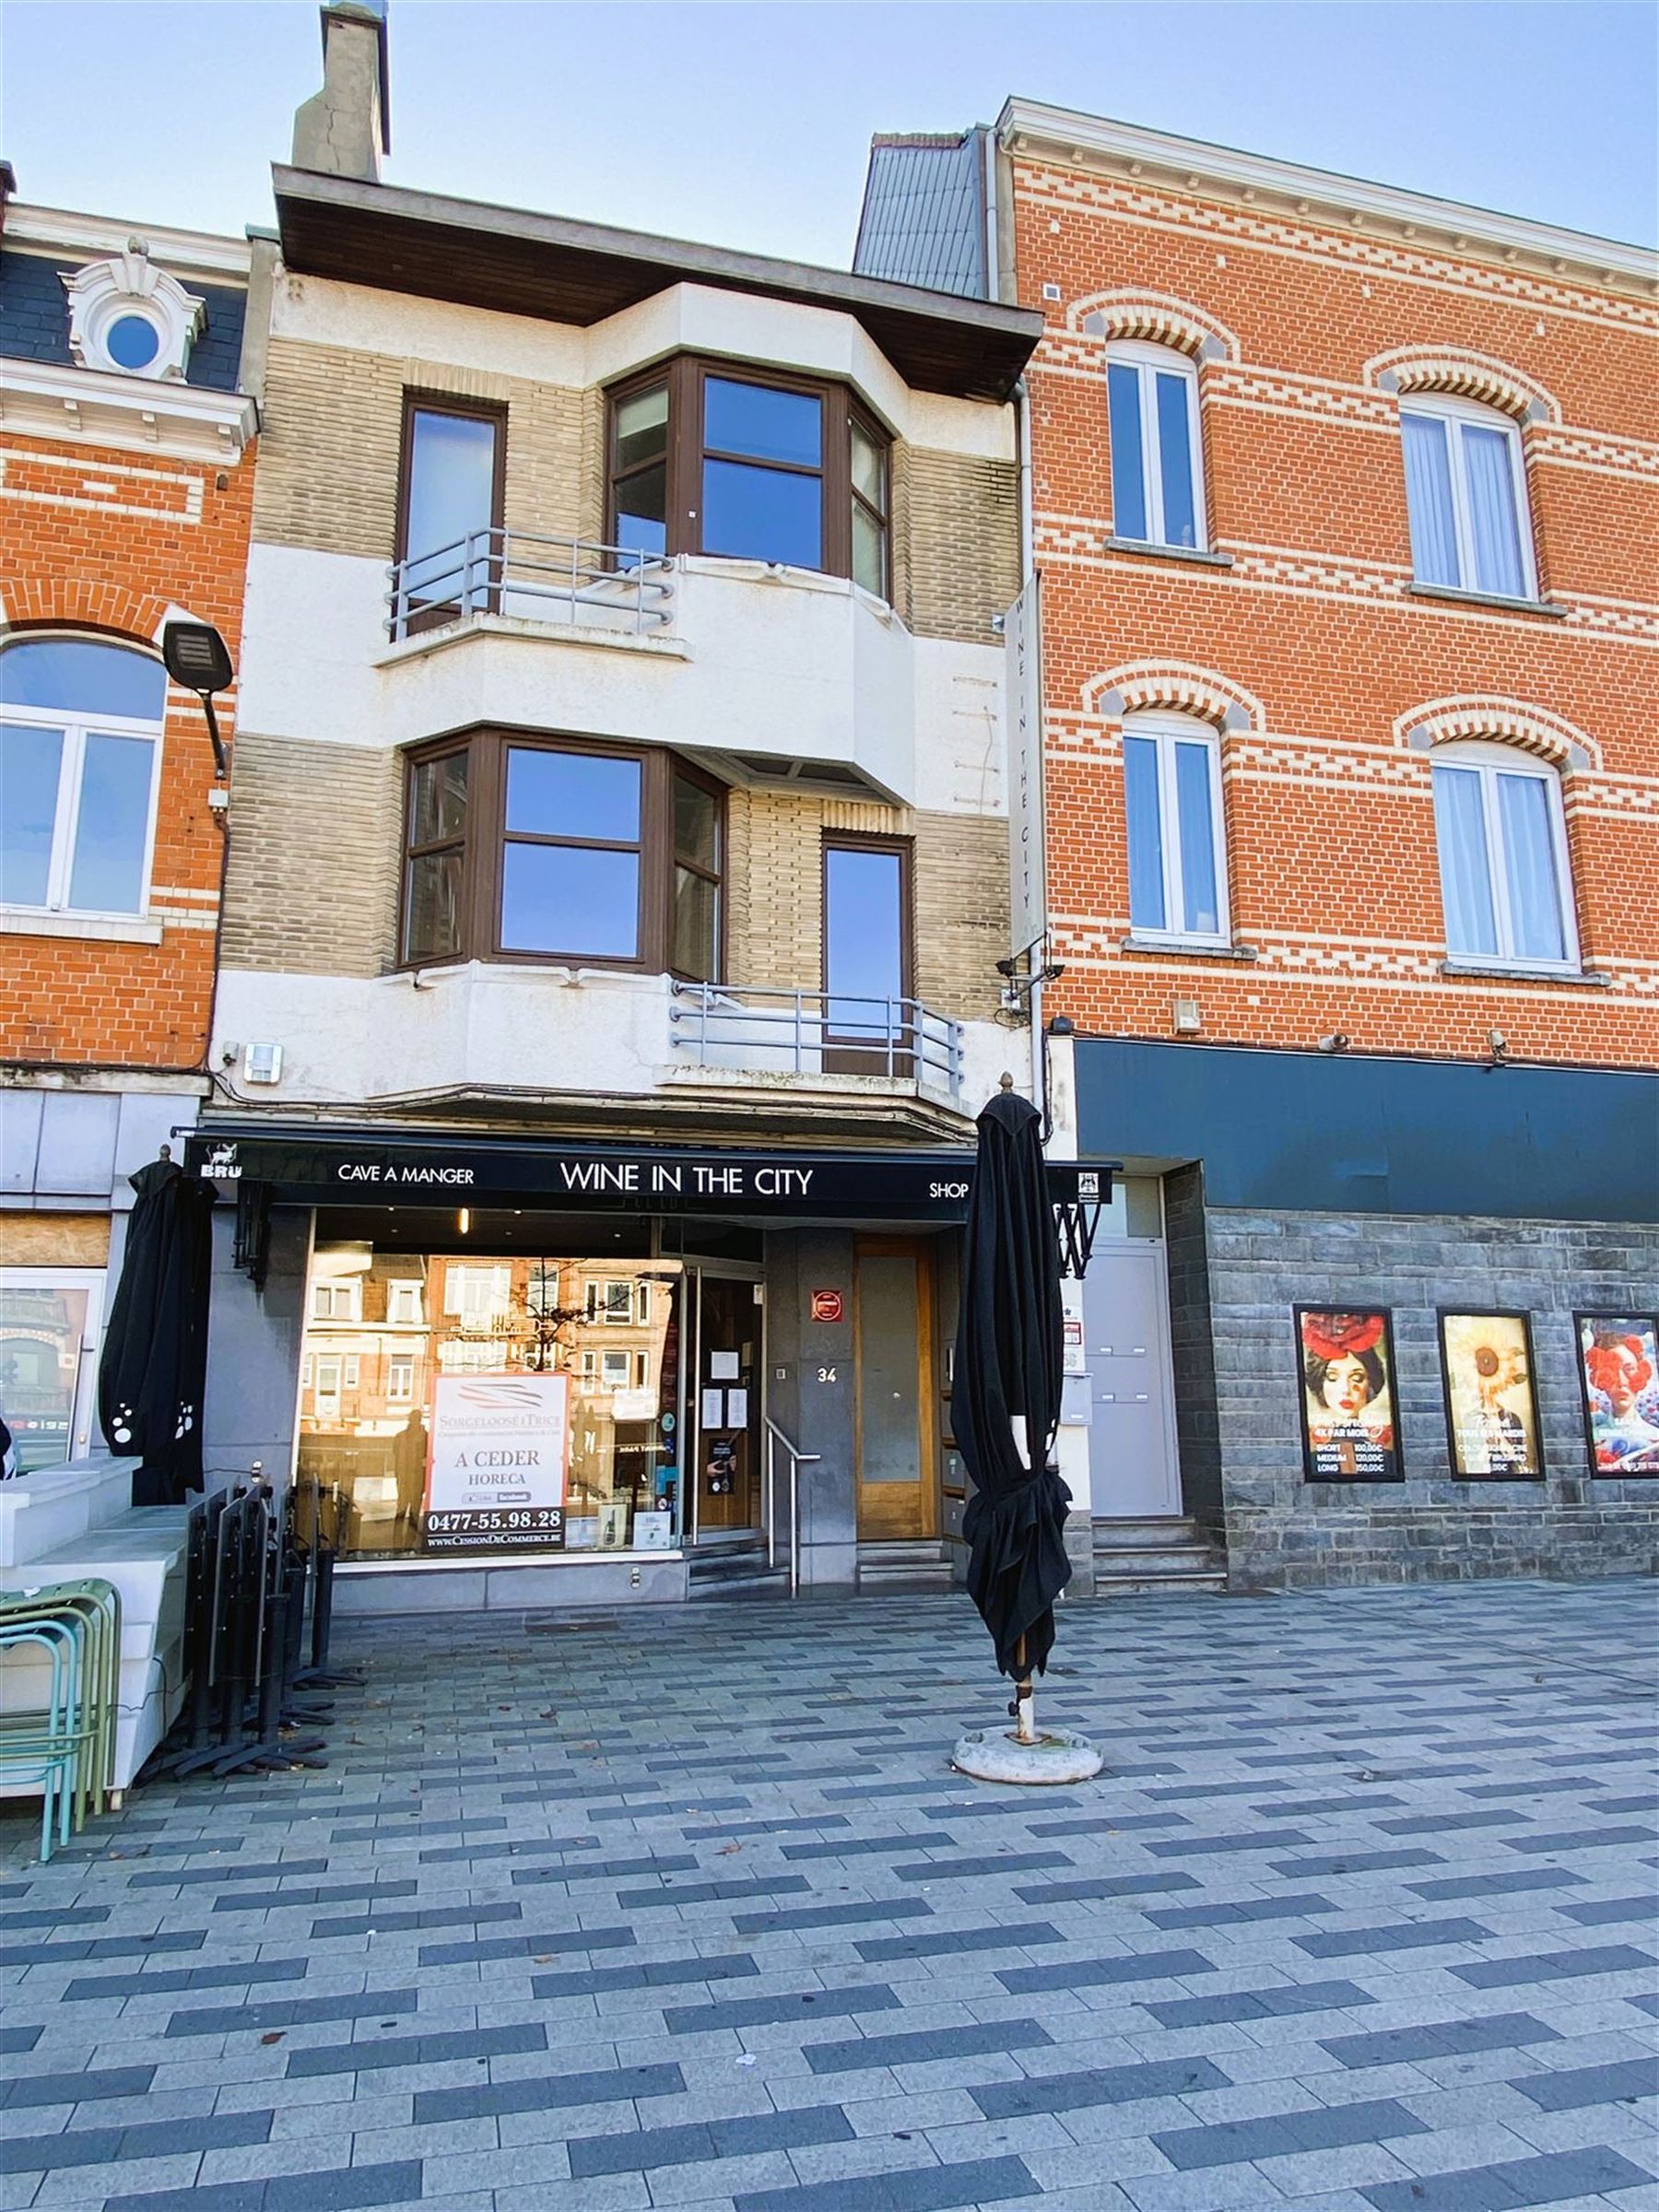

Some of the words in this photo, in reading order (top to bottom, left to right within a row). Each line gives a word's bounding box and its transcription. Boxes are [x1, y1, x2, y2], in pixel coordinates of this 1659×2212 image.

[1016, 594, 1024, 677] WINE
[1018, 695, 1026, 732] IN
[1020, 826, 1030, 910] CITY
[200, 1163, 242, 1179] BRU
[337, 1164, 381, 1182] CAVE
[383, 1166, 398, 1182] A
[401, 1167, 475, 1184] MANGER
[559, 1162, 640, 1191] WINE
[652, 1165, 682, 1193] IN
[692, 1167, 744, 1194] THE
[753, 1169, 814, 1195] CITY
[929, 1182, 970, 1198] SHOP
[817, 1367, 837, 1382] 34
[1316, 1443, 1341, 1453] SHORT
[454, 1453, 468, 1467] A
[474, 1450, 541, 1467] CEDER
[1317, 1453, 1347, 1462] MEDIUM
[1318, 1464, 1339, 1472] LONG
[468, 1473, 526, 1486] HORECA
[428, 1511, 561, 1531] 0477-55.98.28
